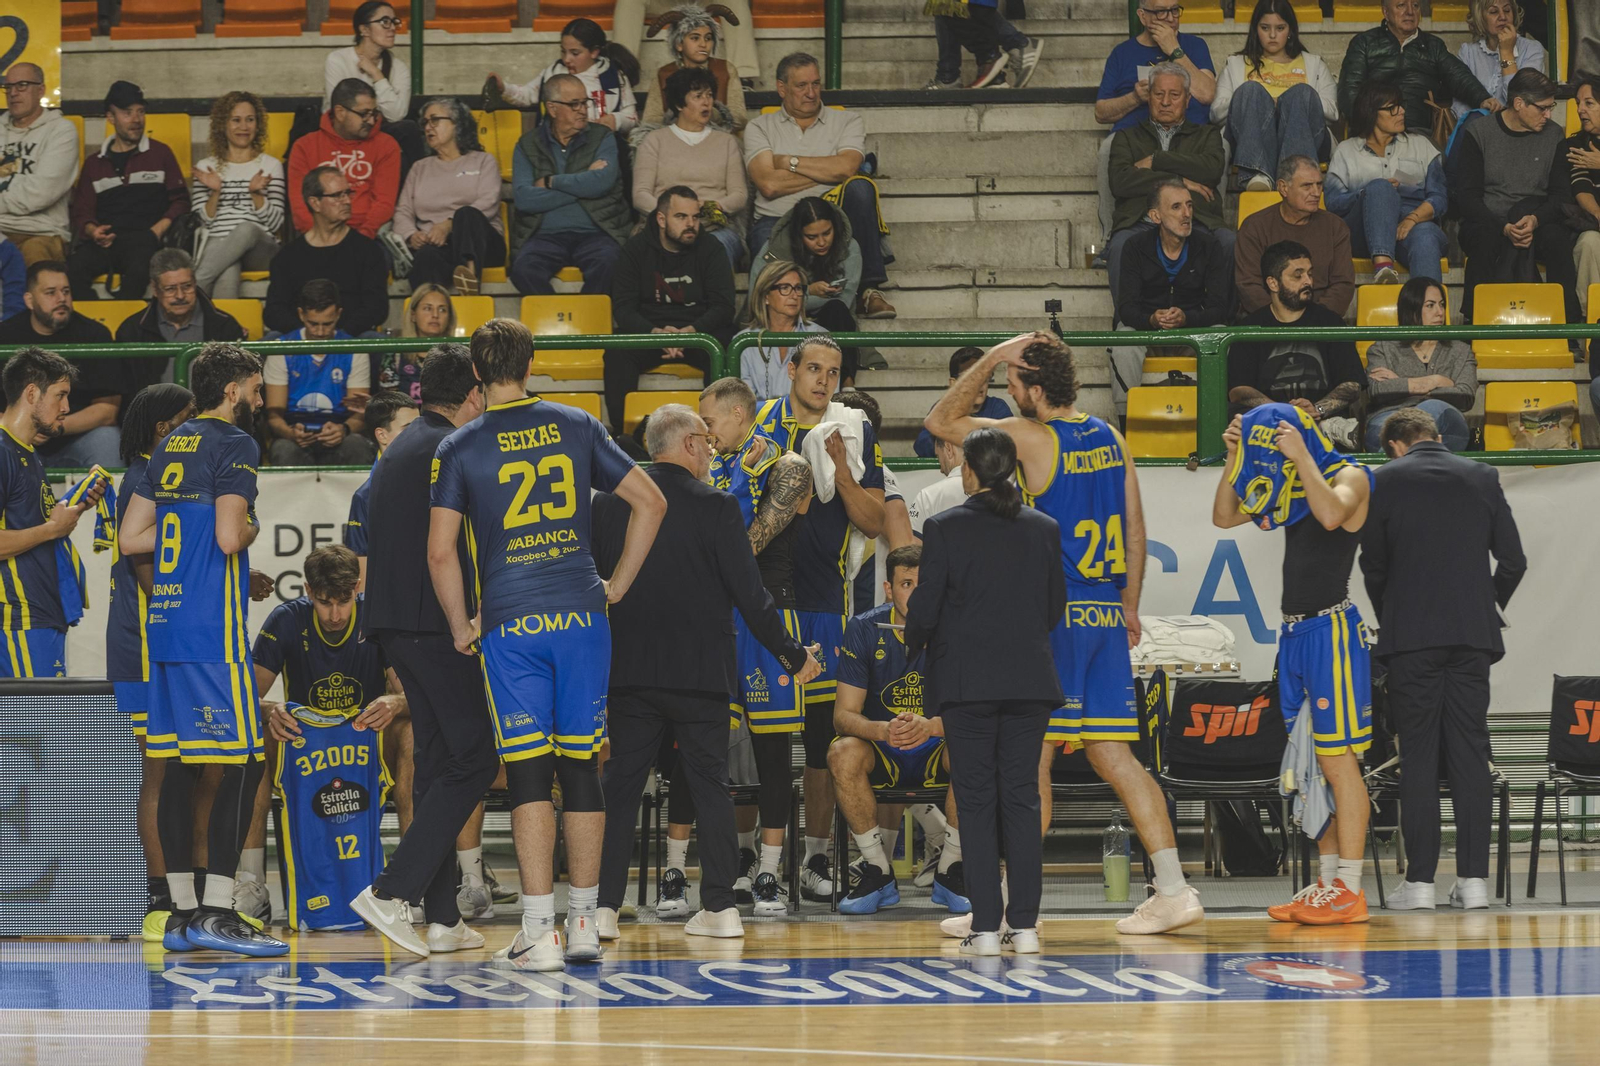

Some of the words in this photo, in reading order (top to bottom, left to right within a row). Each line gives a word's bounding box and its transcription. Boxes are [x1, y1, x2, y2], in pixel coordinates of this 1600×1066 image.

[1509, 301, 1526, 310] 27
[1165, 404, 1184, 414] 24
[1523, 398, 1541, 408] 27
[165, 432, 202, 453] GARCÍA
[497, 423, 561, 452] SEIXAS
[497, 453, 577, 531] 23
[159, 512, 182, 573] 8
[1074, 514, 1127, 578] 24
[506, 552, 547, 564] Xacobeo
[316, 685, 355, 698] Estrella
[317, 698, 355, 709] Galicia
[893, 696, 923, 706] Galici
[295, 745, 370, 776] 32005
[320, 788, 361, 804] Estrella
[323, 801, 361, 815] Galicia
[335, 834, 360, 859] 12
[162, 965, 714, 1003] Estrella
[697, 959, 1227, 999] Galicia
